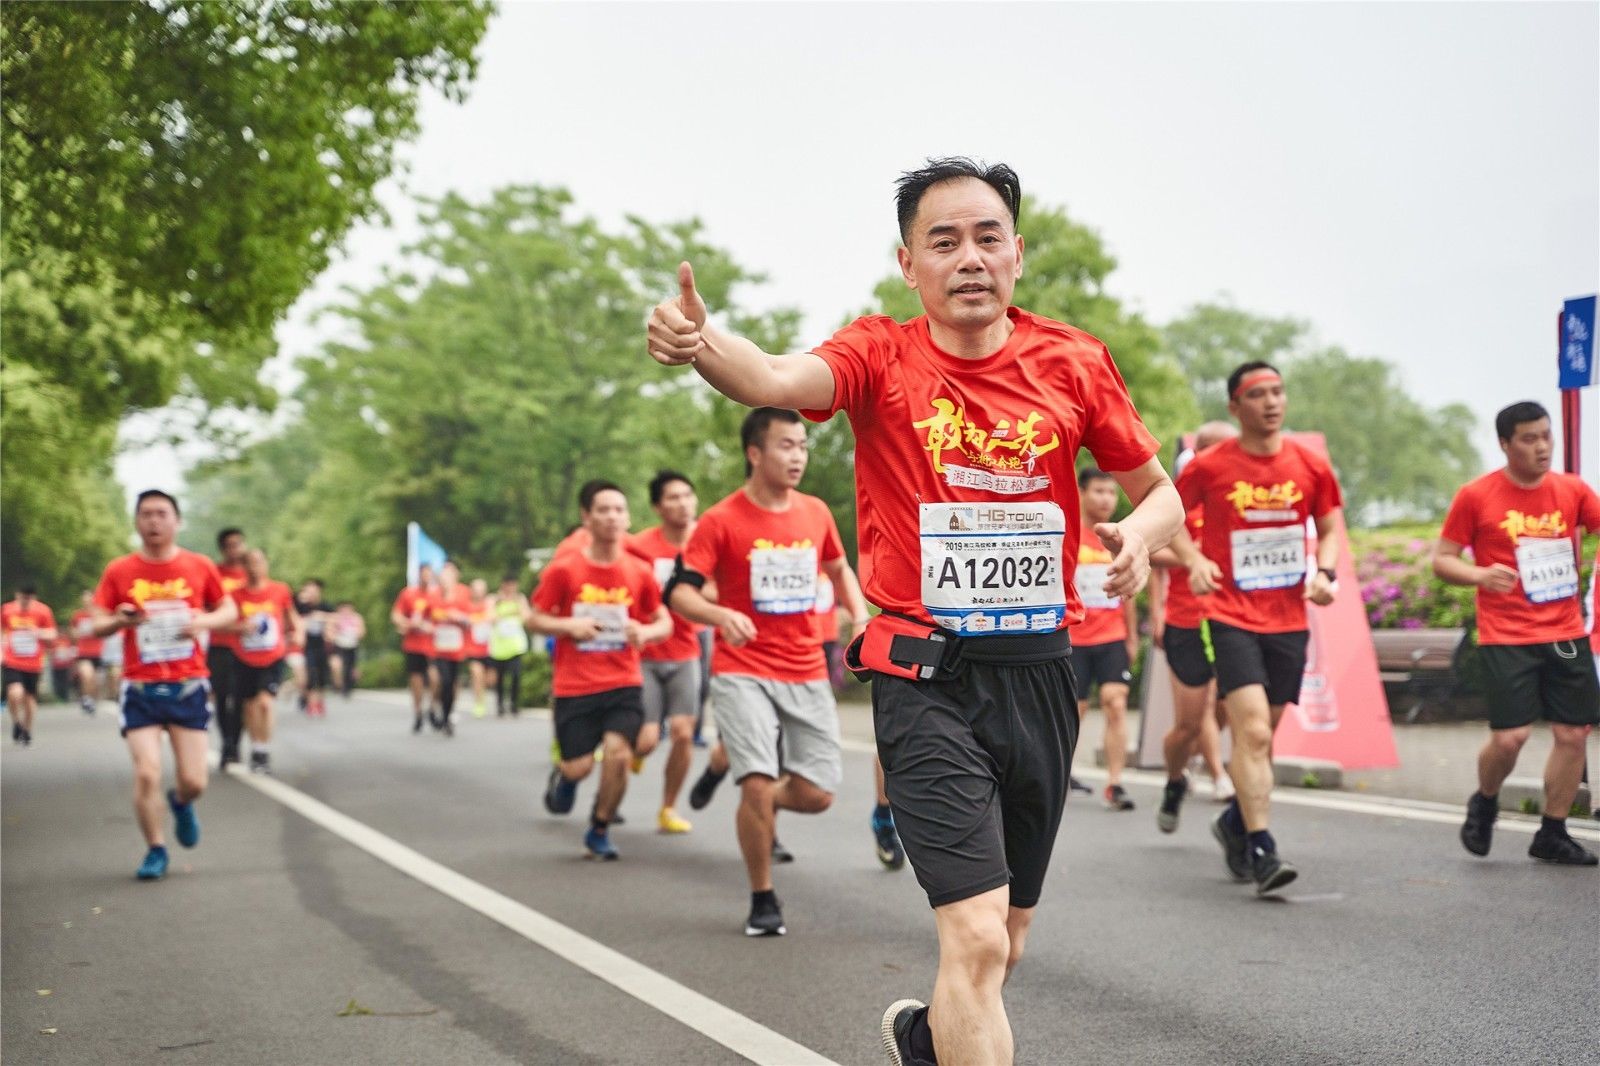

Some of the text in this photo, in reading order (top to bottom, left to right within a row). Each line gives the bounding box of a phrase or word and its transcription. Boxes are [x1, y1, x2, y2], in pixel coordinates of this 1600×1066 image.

[953, 470, 1037, 492] 湘江马拉松赛
[945, 541, 963, 551] 2019
[937, 555, 1049, 588] A12032
